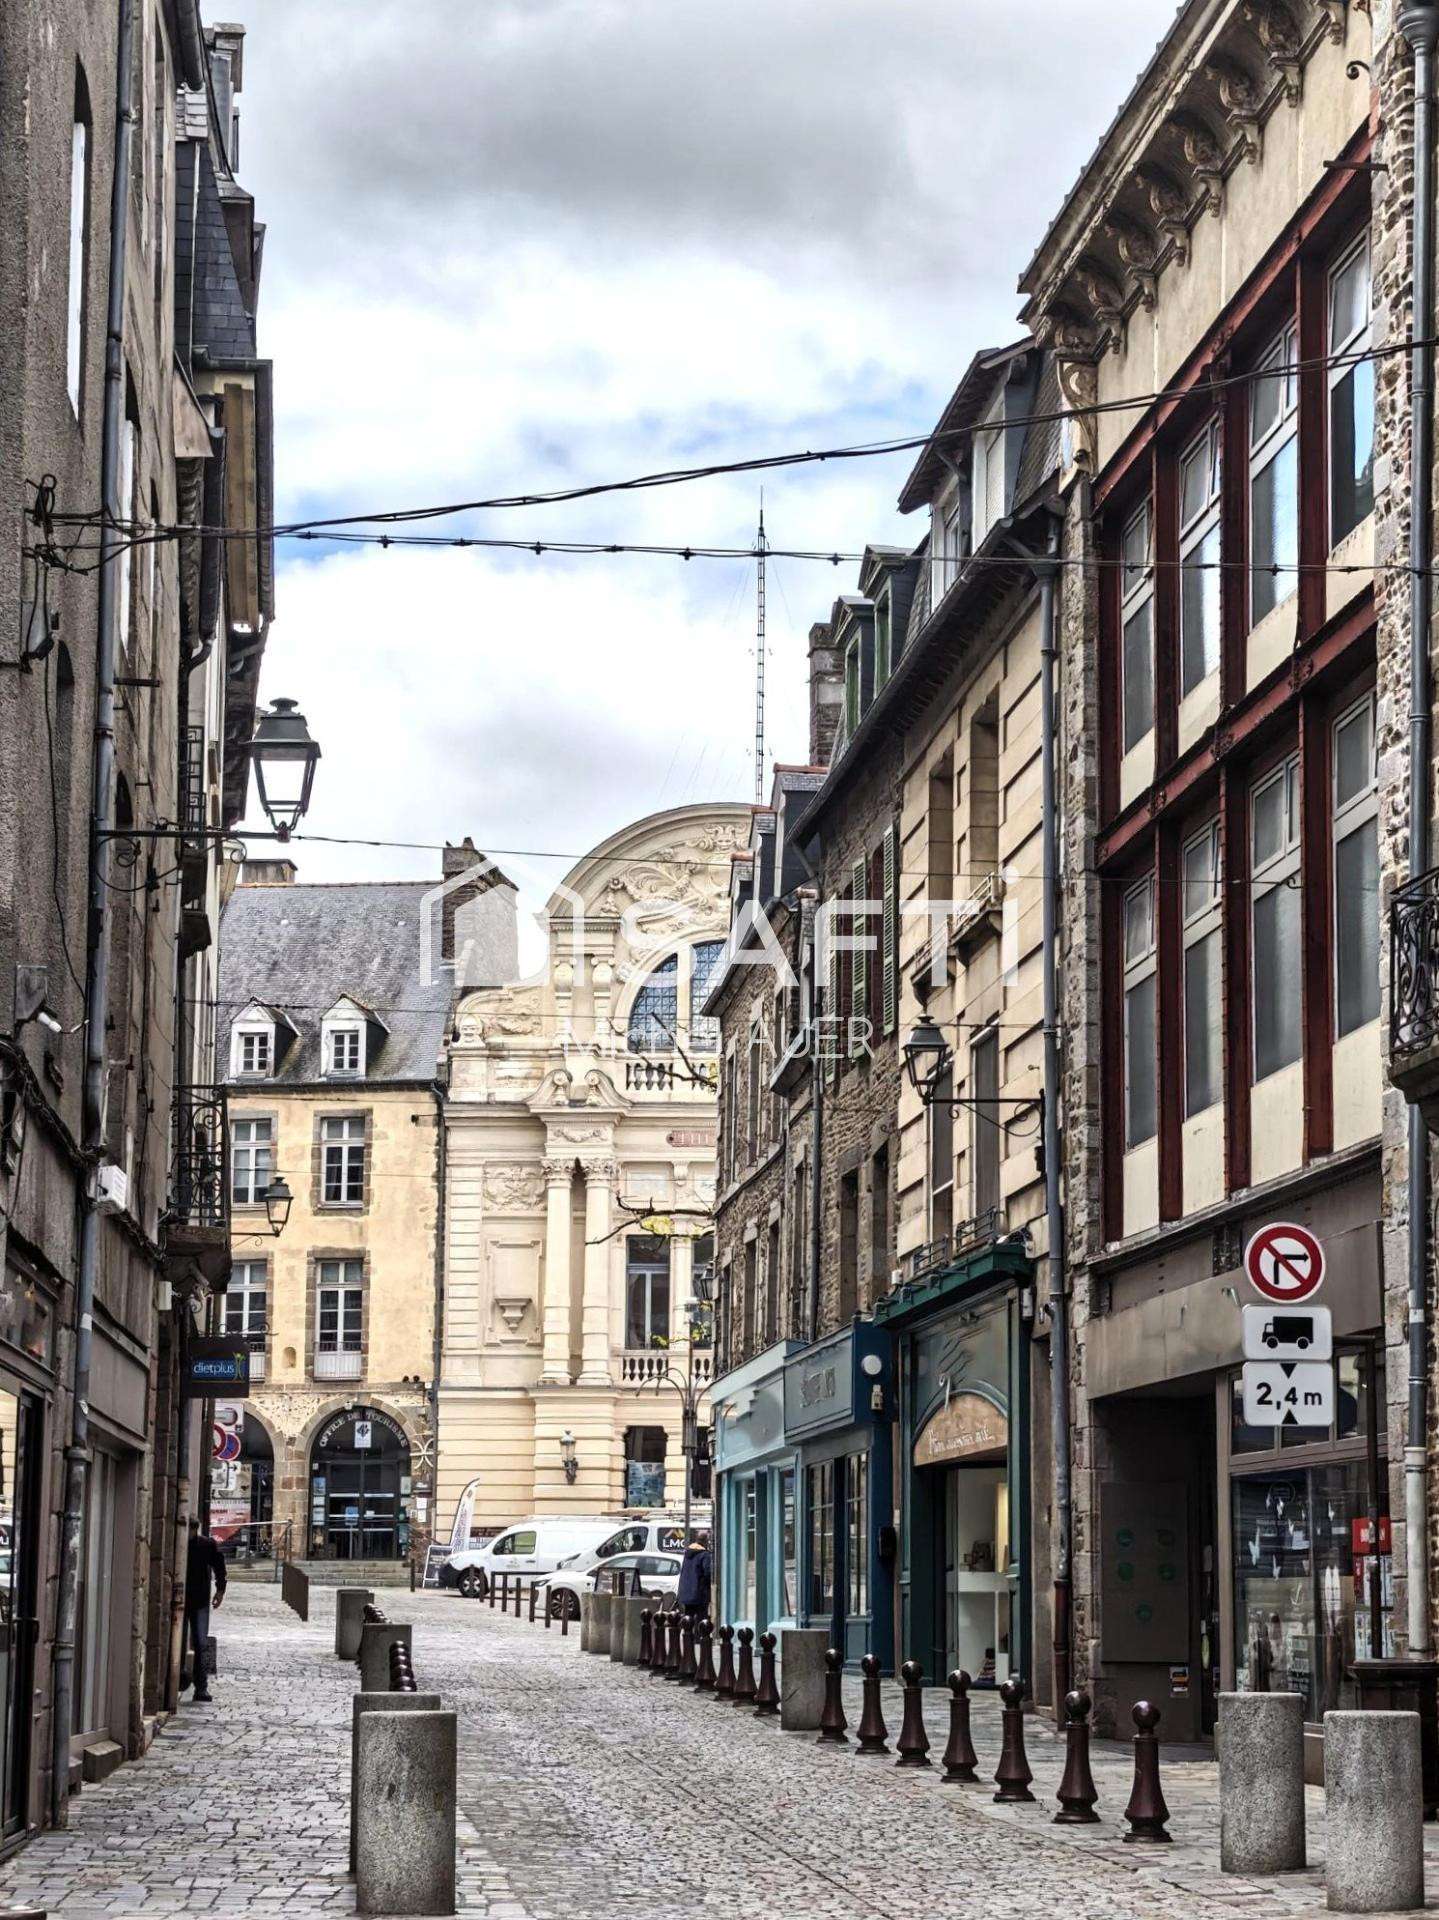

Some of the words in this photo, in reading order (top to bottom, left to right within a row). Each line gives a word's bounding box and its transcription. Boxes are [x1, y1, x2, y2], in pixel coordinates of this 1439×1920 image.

[193, 1361, 235, 1376] dietplus
[1256, 1382, 1298, 1410] 2,4
[1304, 1391, 1322, 1405] m
[319, 1416, 346, 1447] OFFICE
[346, 1411, 361, 1421] DE
[365, 1411, 408, 1447] TOURISME
